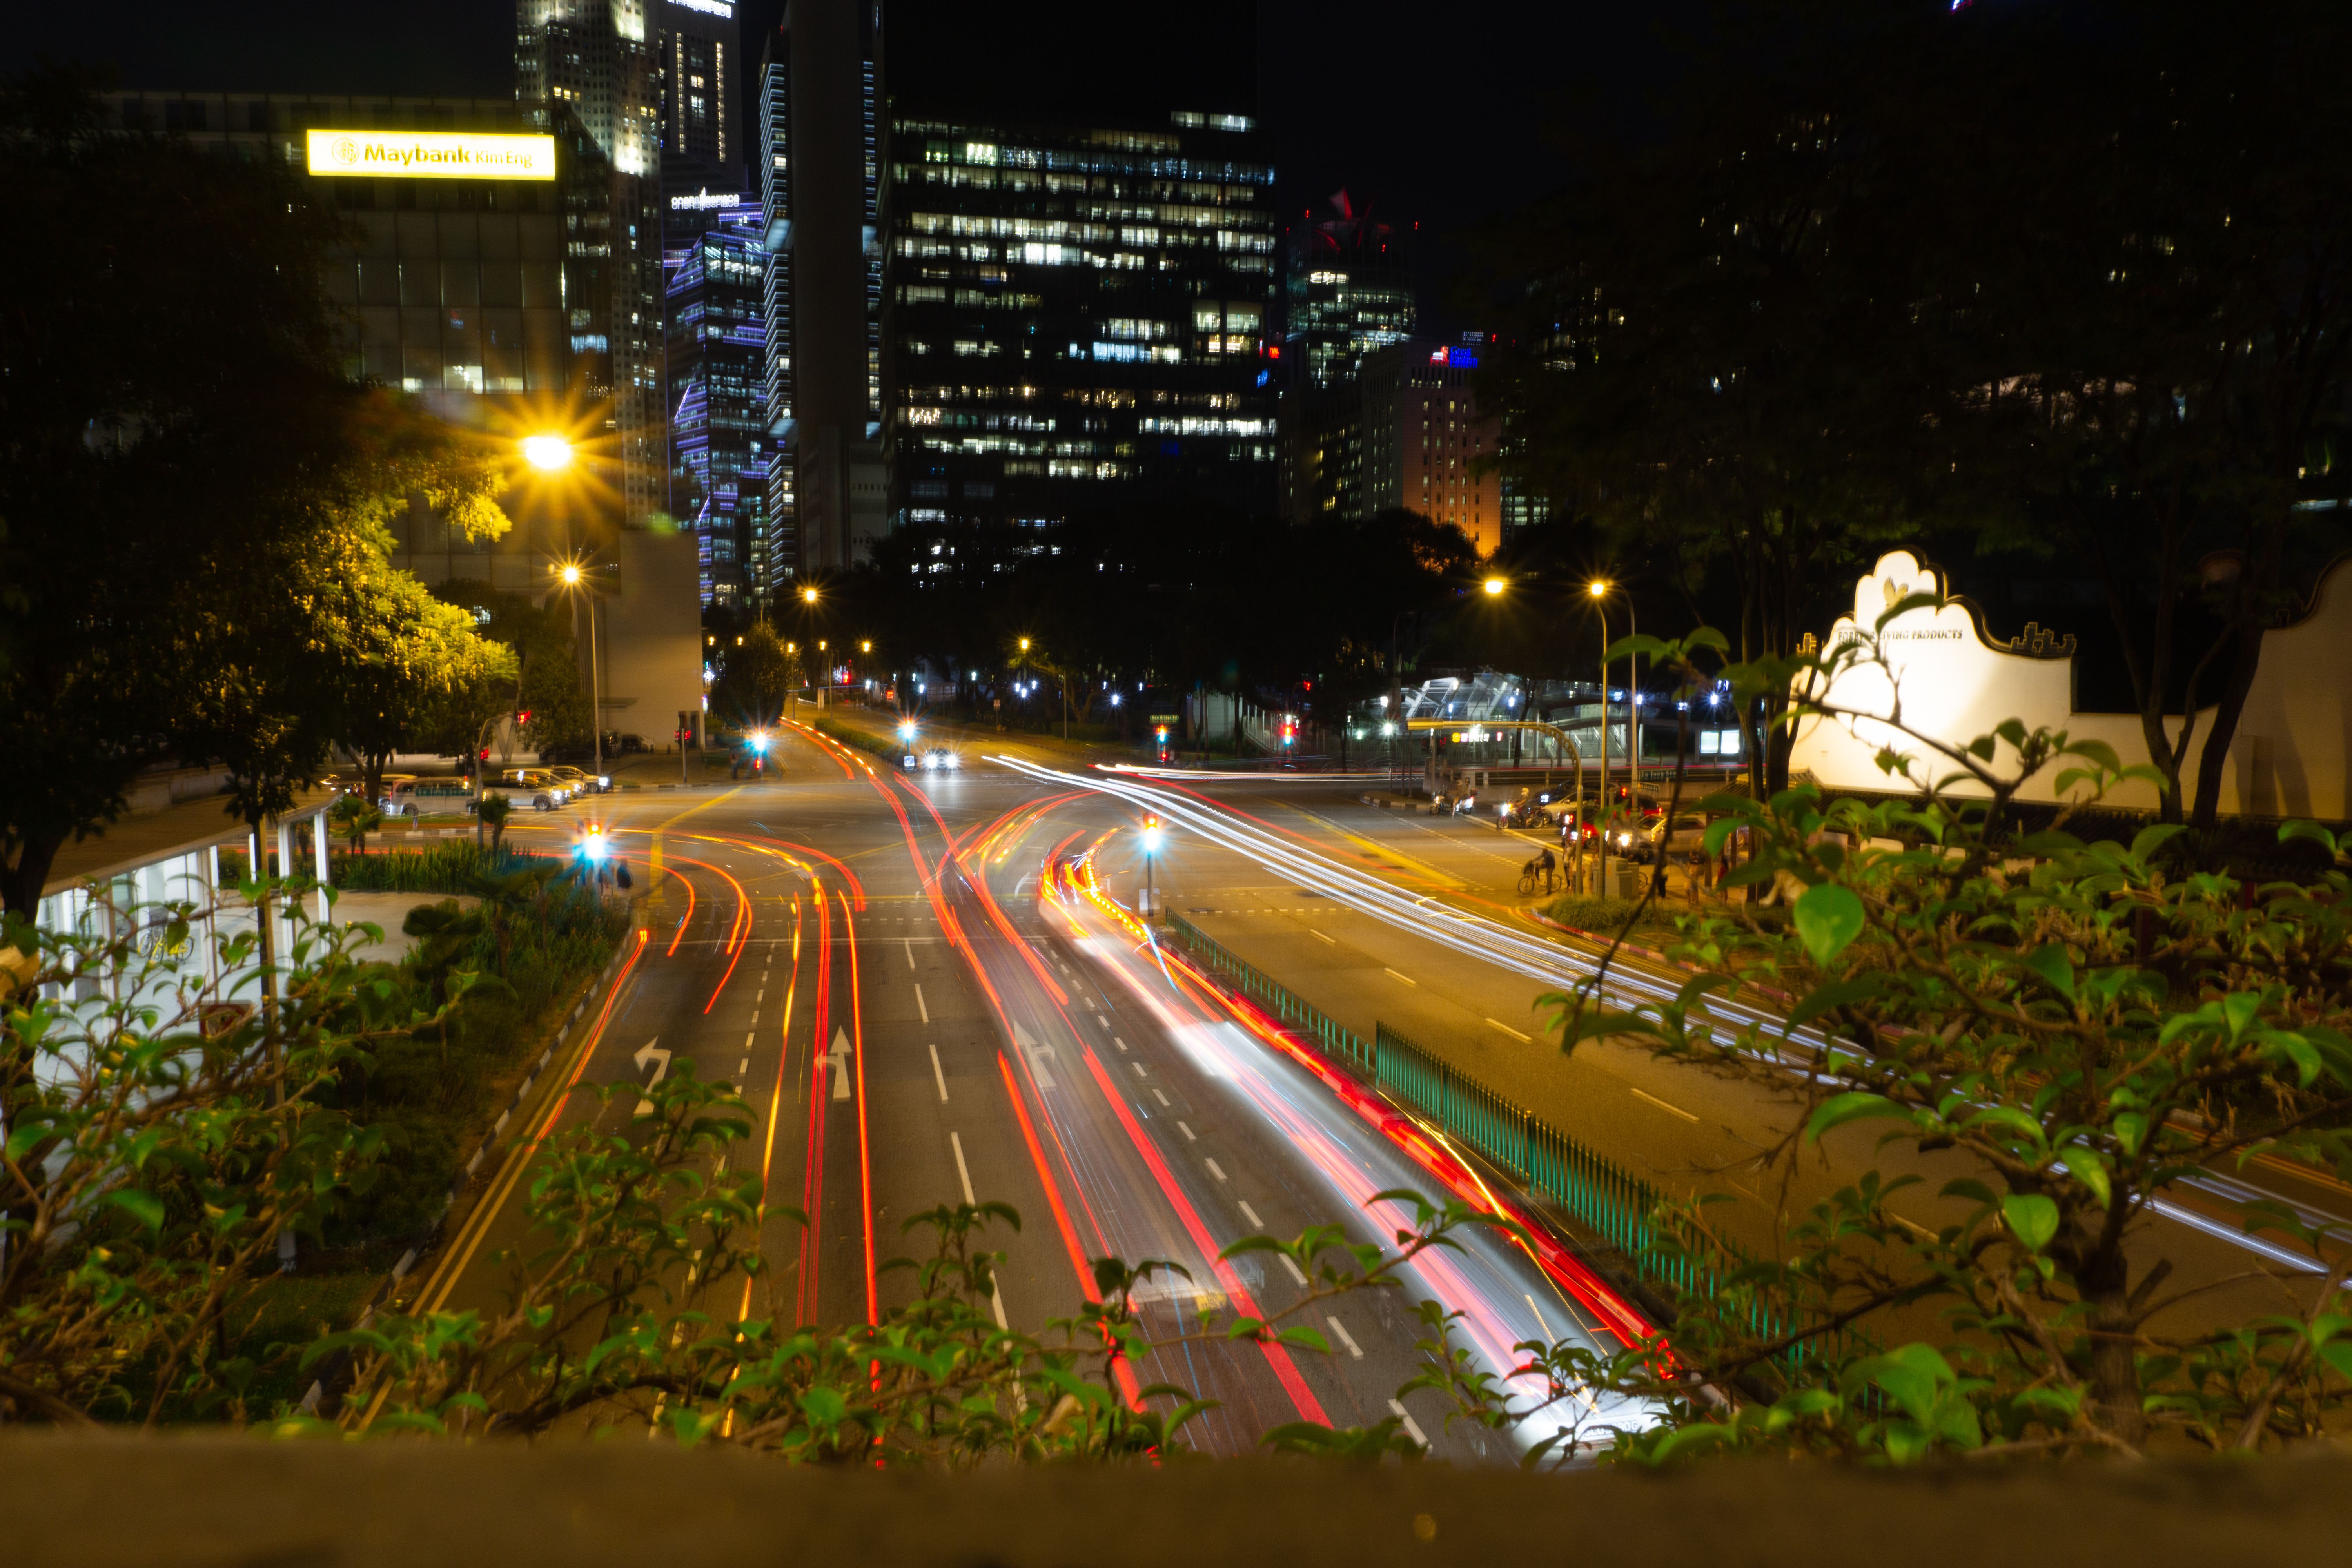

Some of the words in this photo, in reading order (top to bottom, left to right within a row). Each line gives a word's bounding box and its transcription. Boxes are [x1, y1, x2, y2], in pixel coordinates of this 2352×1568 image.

[364, 143, 470, 166] Maybank
[476, 150, 503, 163] Kim
[506, 151, 532, 169] Eng
[1451, 346, 1471, 355] Great
[1912, 629, 1963, 640] PRODUCTS
